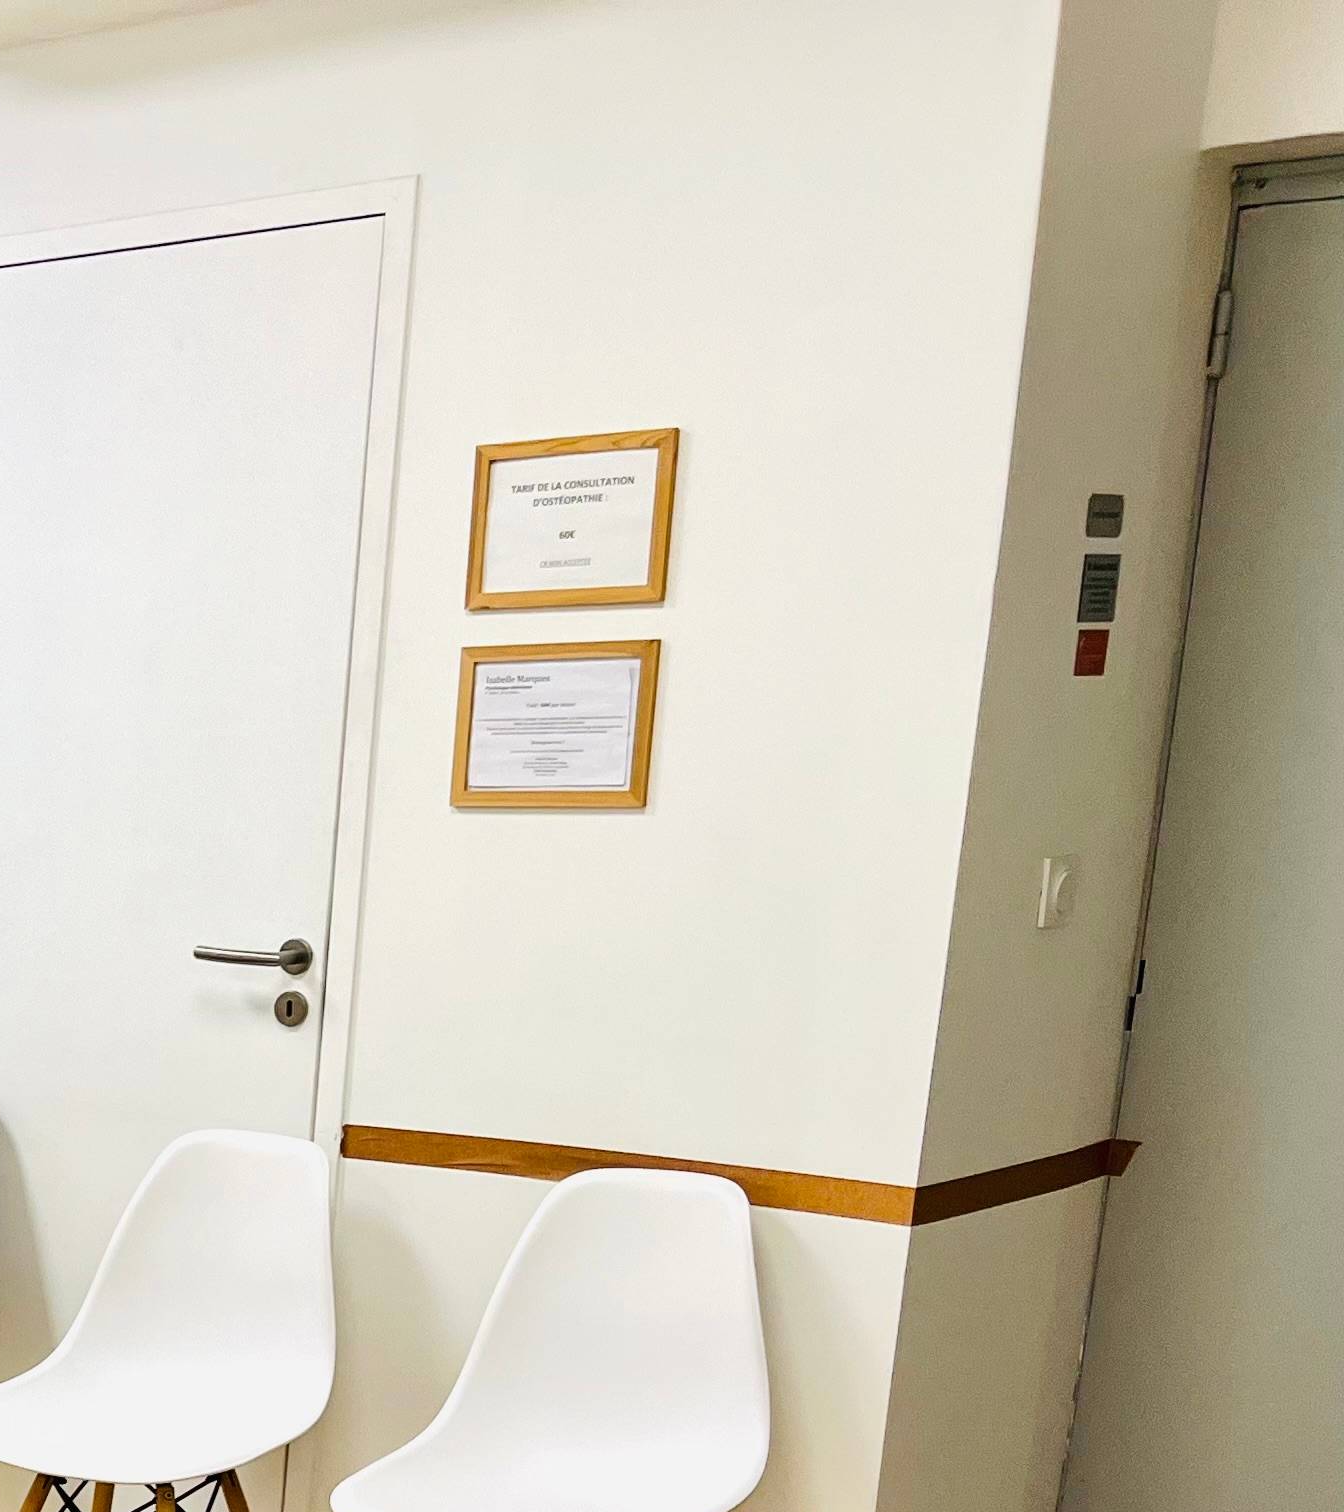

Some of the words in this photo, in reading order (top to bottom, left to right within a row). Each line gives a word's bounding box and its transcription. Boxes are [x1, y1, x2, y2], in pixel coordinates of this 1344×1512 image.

[511, 483, 535, 493] TARIF
[537, 482, 550, 492] DE
[551, 481, 562, 491] LA
[563, 476, 635, 490] CONSULTATION
